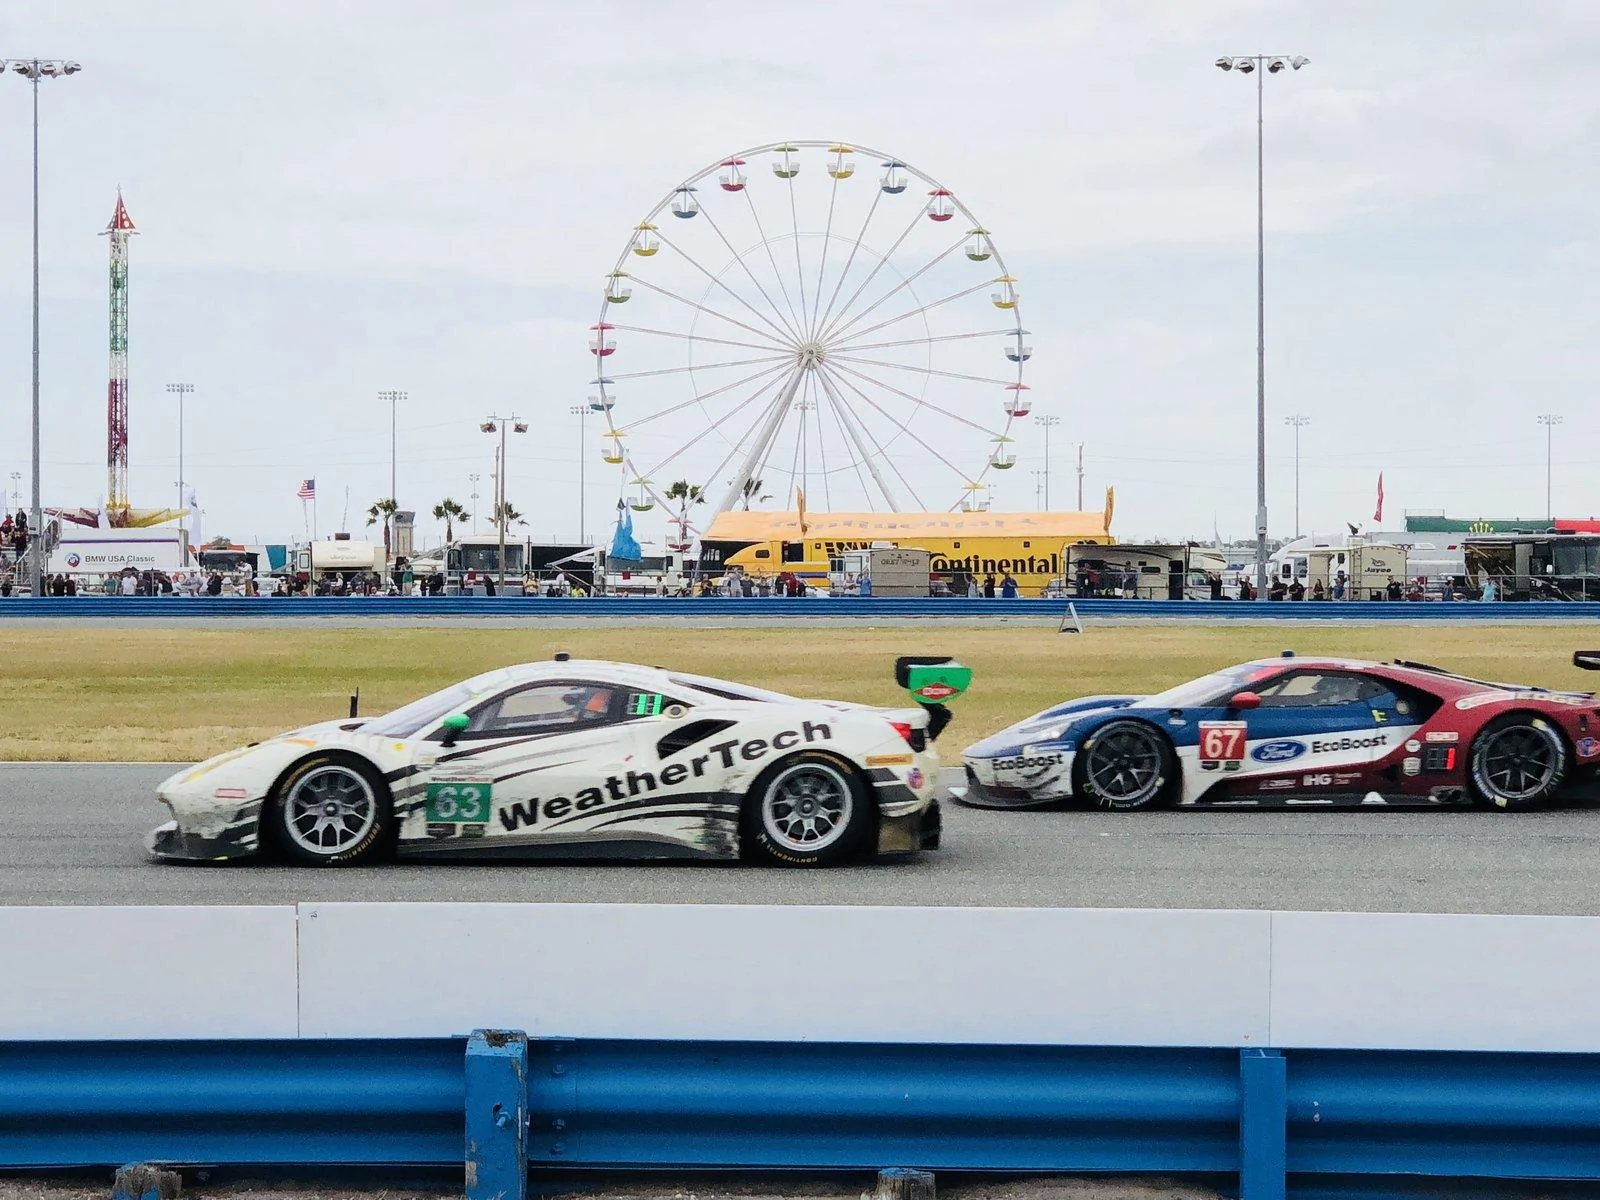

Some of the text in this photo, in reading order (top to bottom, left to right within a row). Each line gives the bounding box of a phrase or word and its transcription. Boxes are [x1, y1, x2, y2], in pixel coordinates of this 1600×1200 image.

[1205, 729, 1240, 758] 67
[1260, 743, 1297, 759] Ford
[1312, 735, 1387, 753] EcoBoost
[992, 753, 1063, 770] EcoBoost
[499, 720, 832, 831] WeatherTech
[1303, 774, 1332, 786] IHG
[435, 786, 481, 818] 63
